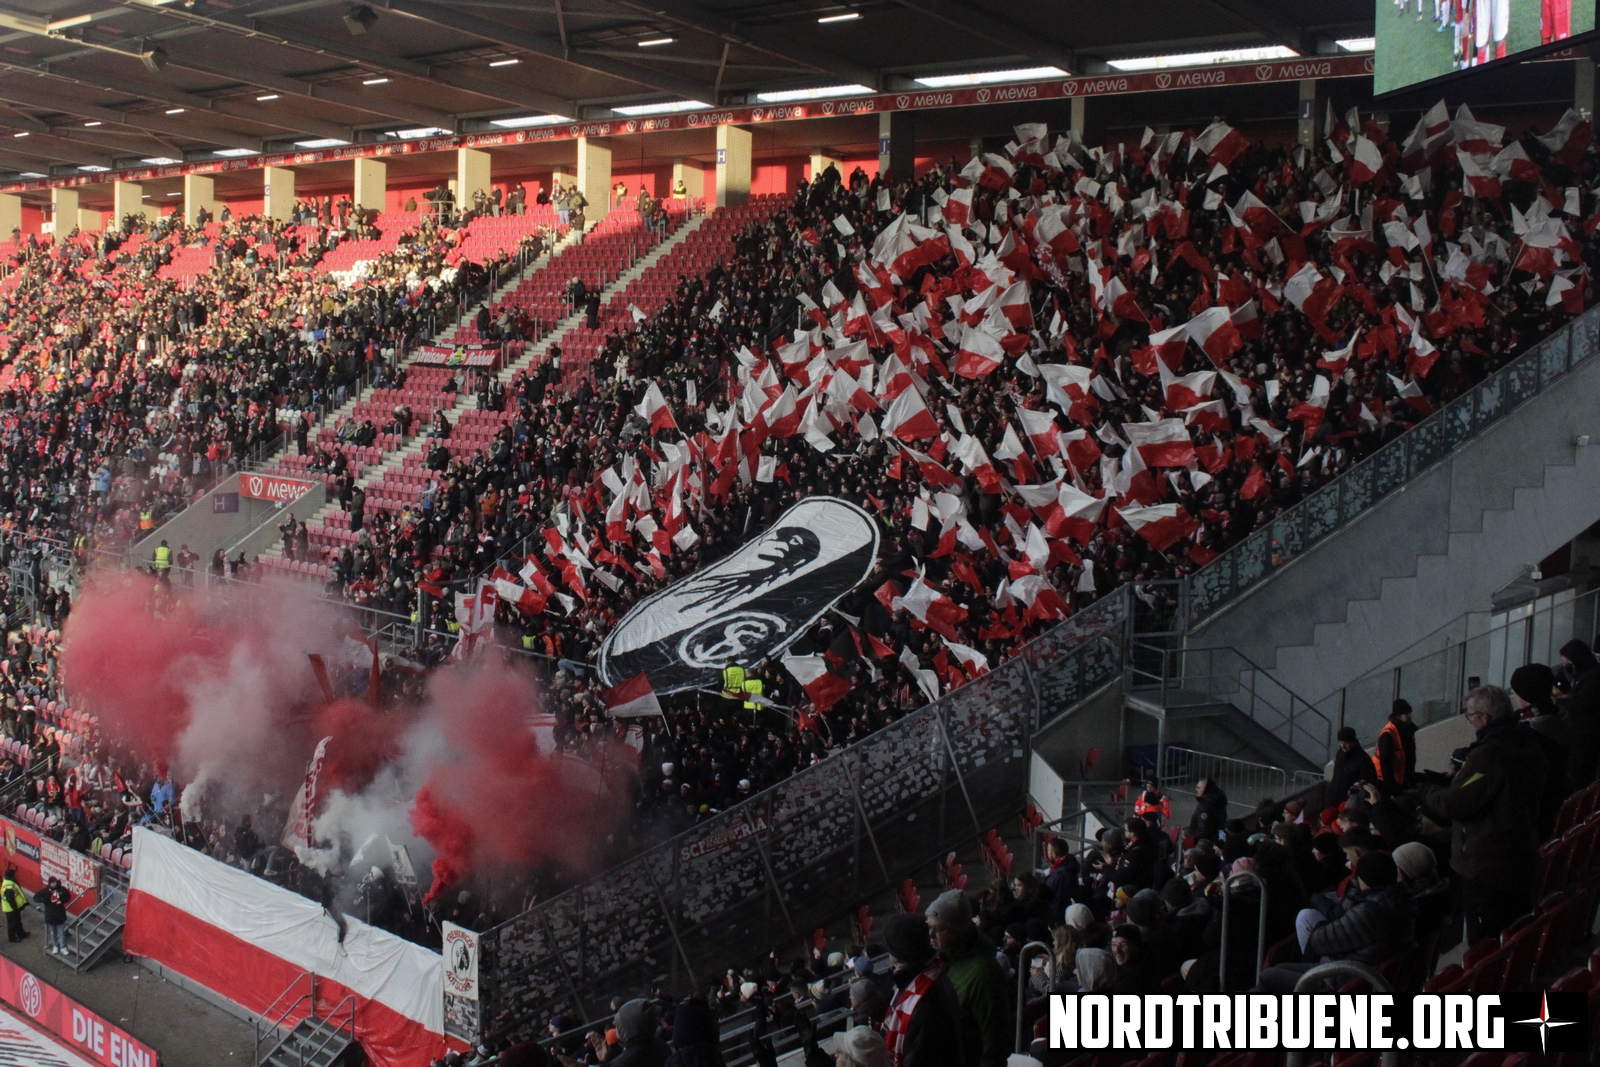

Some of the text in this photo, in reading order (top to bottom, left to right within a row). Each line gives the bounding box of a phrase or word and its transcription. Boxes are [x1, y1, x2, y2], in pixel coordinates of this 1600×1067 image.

[1278, 62, 1331, 78] Mewa
[1177, 70, 1226, 86] Mewa
[995, 86, 1037, 100] Mewa
[1082, 79, 1128, 94] Mewa
[838, 100, 874, 113] Mewa
[914, 93, 953, 107] Mewa
[701, 112, 734, 124] Mewa
[767, 106, 802, 119] Mewa
[582, 123, 610, 135] Mewa
[640, 118, 670, 130] Mewa
[528, 129, 554, 140] Mewa
[718, 152, 726, 162] H
[264, 186, 270, 195] G
[214, 496, 225, 510] H
[446, 930, 474, 948] FREIBURGER
[73, 1008, 104, 1057] DIE
